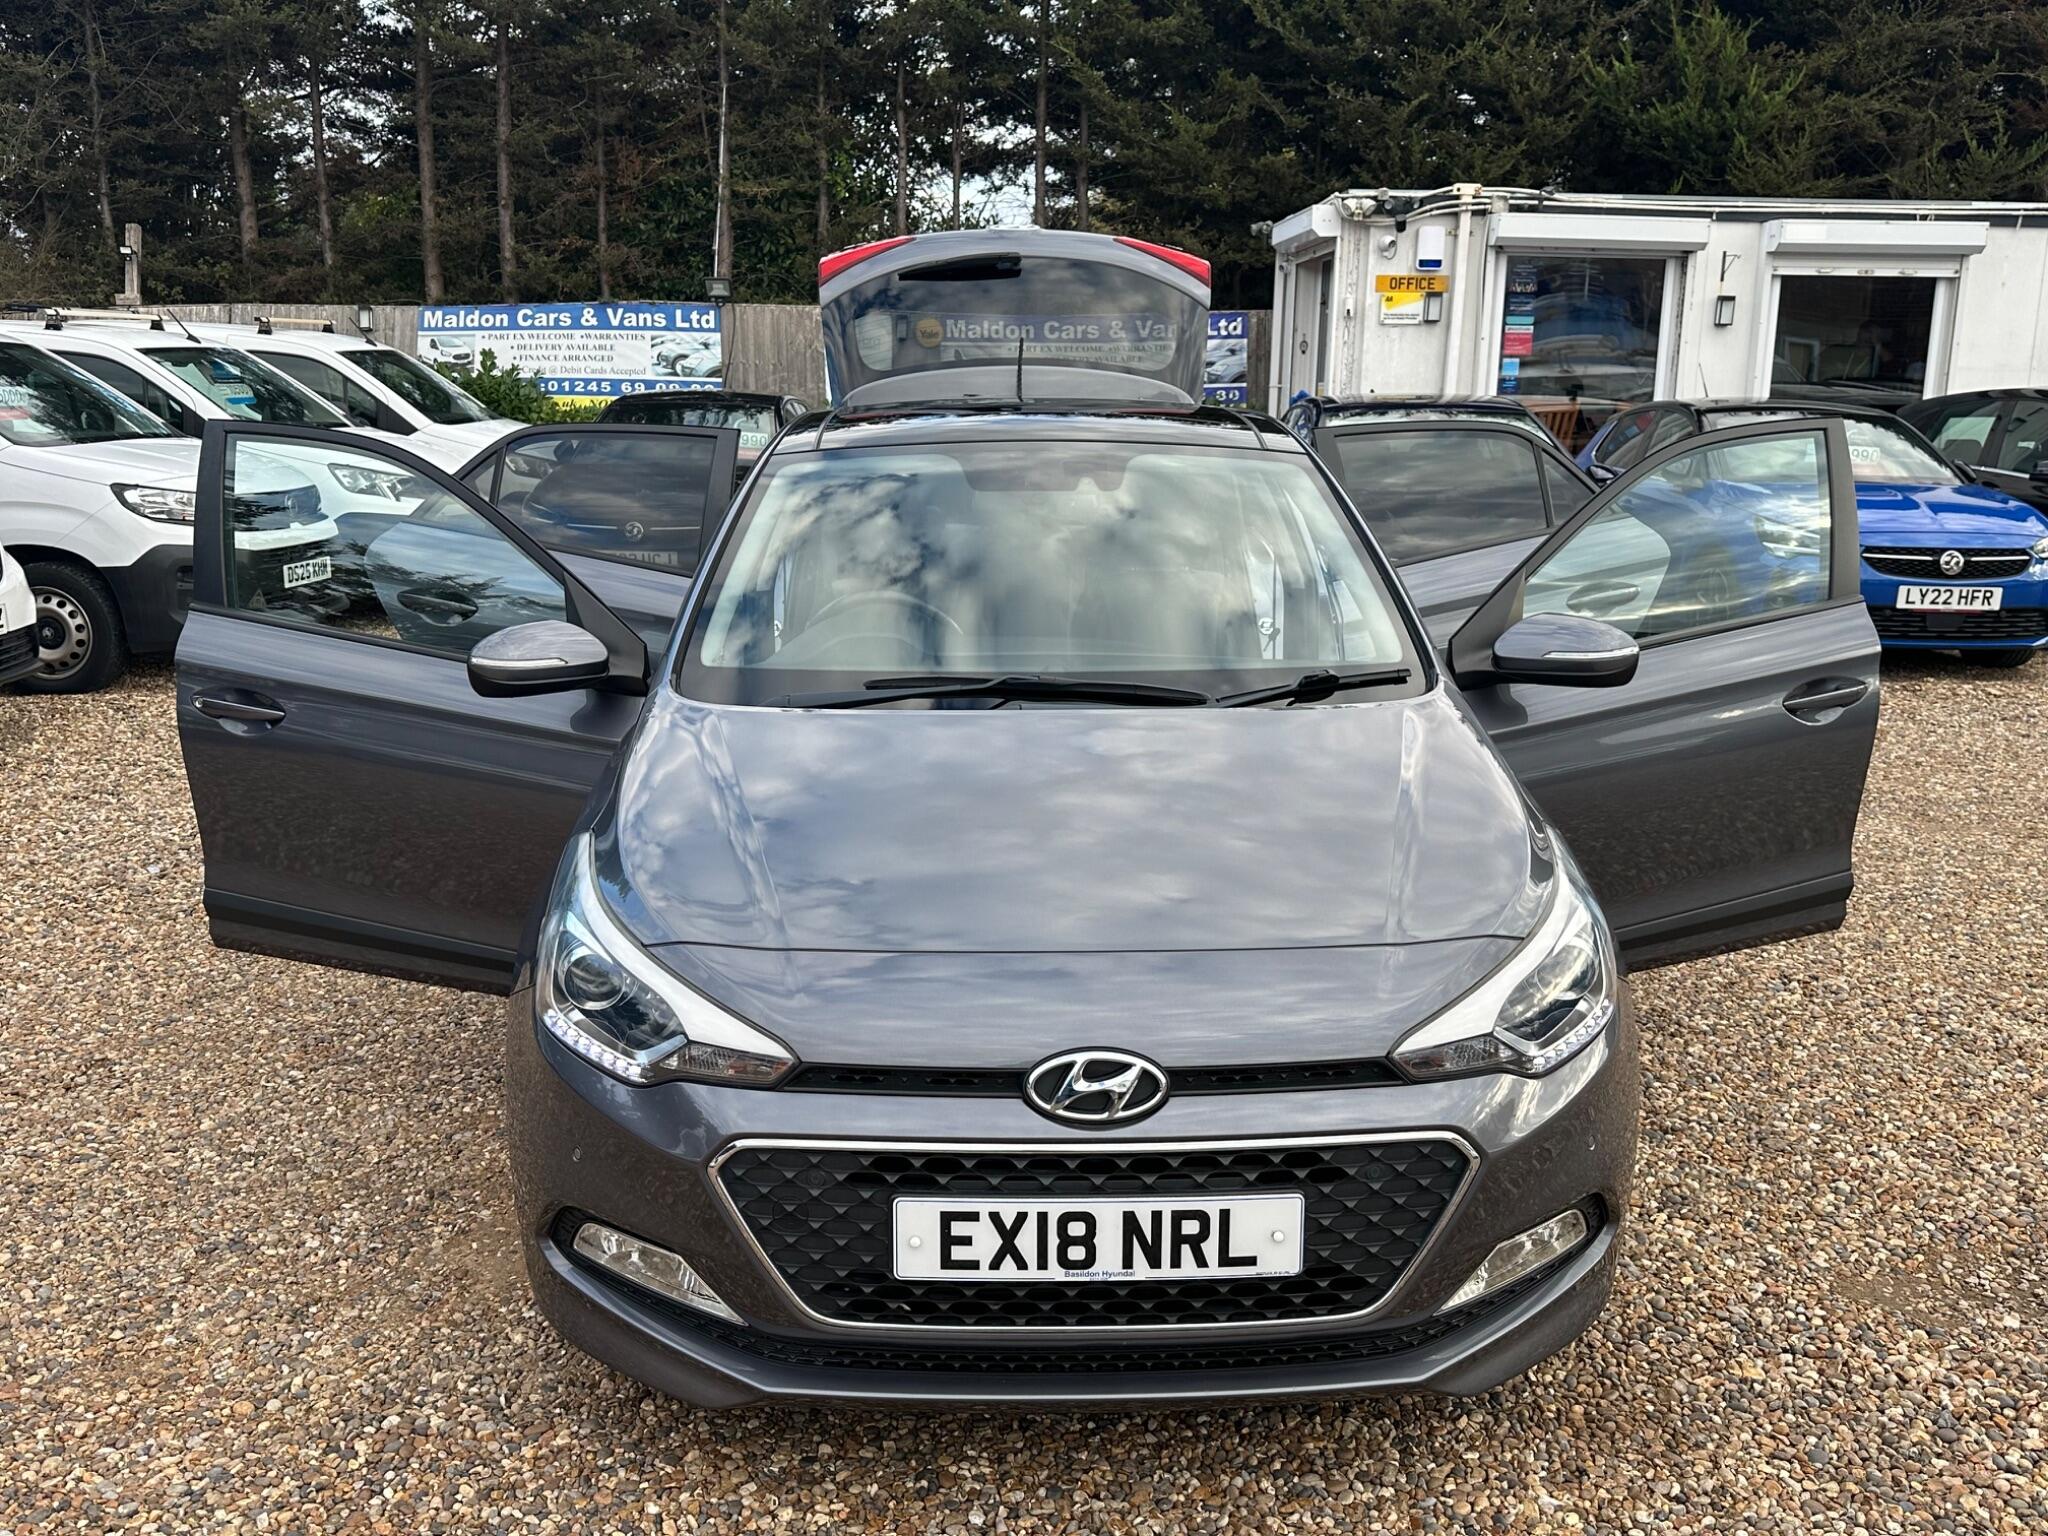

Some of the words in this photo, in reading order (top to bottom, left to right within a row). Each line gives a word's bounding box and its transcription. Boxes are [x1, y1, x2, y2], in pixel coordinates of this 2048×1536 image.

[1389, 277, 1436, 290] OFFICE
[423, 310, 509, 328] Maldon
[517, 308, 572, 327] Cars
[580, 307, 599, 326] &
[606, 308, 667, 328] Vans
[675, 309, 716, 329] Ltd
[945, 319, 1035, 339] Maldon
[1043, 321, 1100, 339] Cars
[1109, 320, 1127, 338] &
[1135, 320, 1178, 338] Van
[1207, 317, 1243, 336] Ltd
[487, 333, 511, 341] PART
[513, 333, 525, 341] EX
[527, 333, 576, 341] WELCOME
[585, 333, 646, 341] WARRANTIES
[516, 343, 562, 351] DELIVERY
[566, 343, 616, 352] AVAILABLE
[1055, 344, 1104, 352] WELCOME
[519, 354, 559, 362] FINANCE
[562, 354, 614, 363] ARRANGED
[560, 367, 582, 375] Debit
[584, 367, 607, 375] Cards
[608, 367, 647, 377] Accepted
[287, 562, 312, 583] DS25
[1905, 588, 1954, 606] LY22
[1957, 589, 1994, 606] HFR
[939, 1210, 1097, 1271] EX18
[1122, 1208, 1258, 1270] NRL
[1064, 1270, 1100, 1278] Basildon
[1101, 1270, 1136, 1279] Hyundai
